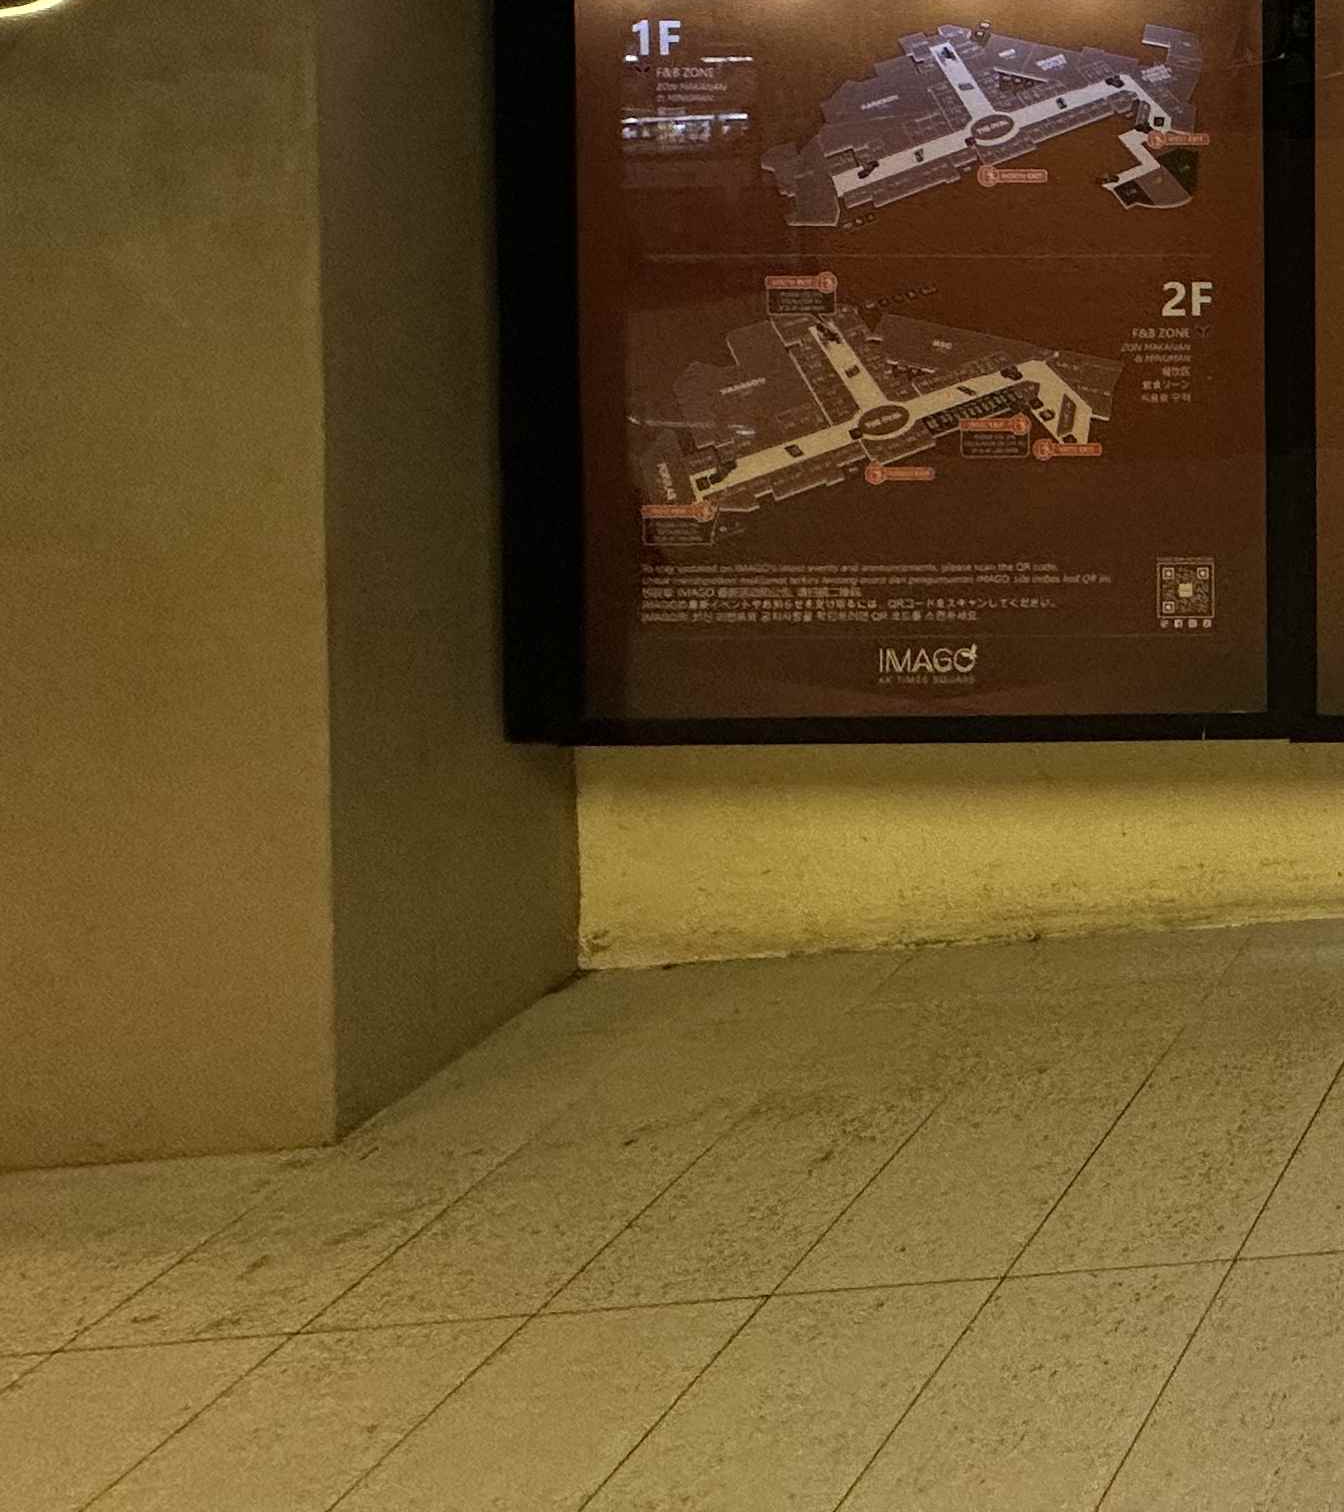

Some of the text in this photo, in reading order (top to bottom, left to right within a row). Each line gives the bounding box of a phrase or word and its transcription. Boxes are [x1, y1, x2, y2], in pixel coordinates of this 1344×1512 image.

[628, 20, 680, 55] 1F
[1162, 282, 1212, 316] 2F
[880, 644, 977, 672] IMAGO
